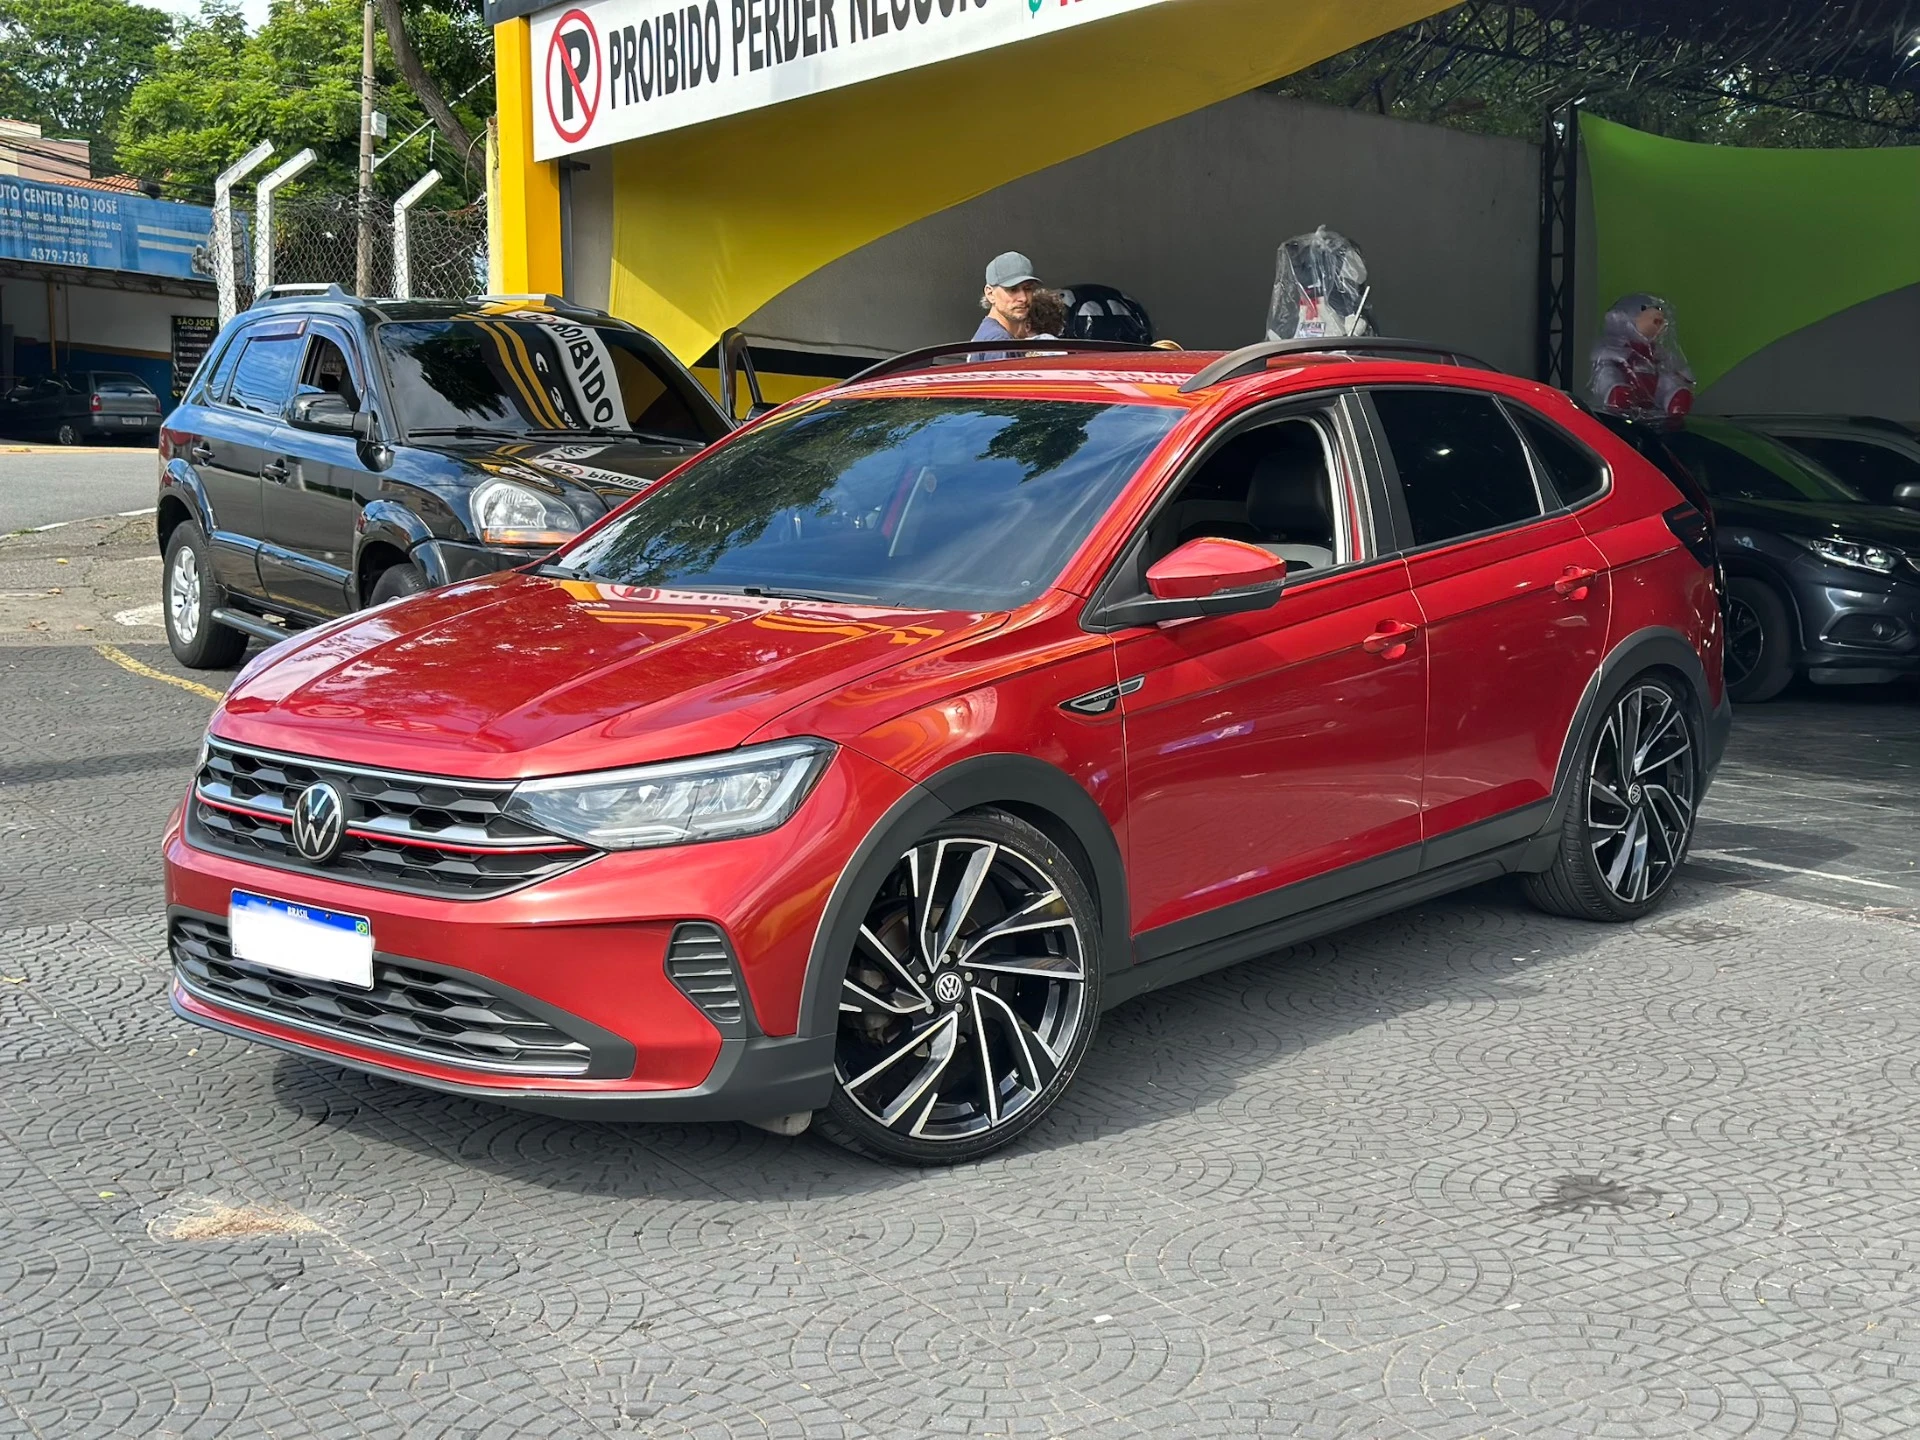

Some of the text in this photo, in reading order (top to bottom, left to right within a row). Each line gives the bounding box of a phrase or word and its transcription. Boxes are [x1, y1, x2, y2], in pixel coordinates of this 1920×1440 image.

[609, 0, 720, 110] PROIBIDO
[732, 0, 838, 77] PERDER
[0, 184, 118, 214] UTO CENTER SÃO JOSÉ
[177, 317, 215, 327] SÃO JOSÉ
[292, 780, 343, 863] VW
[287, 906, 309, 920] BRASIL
[936, 973, 964, 1002] VW
